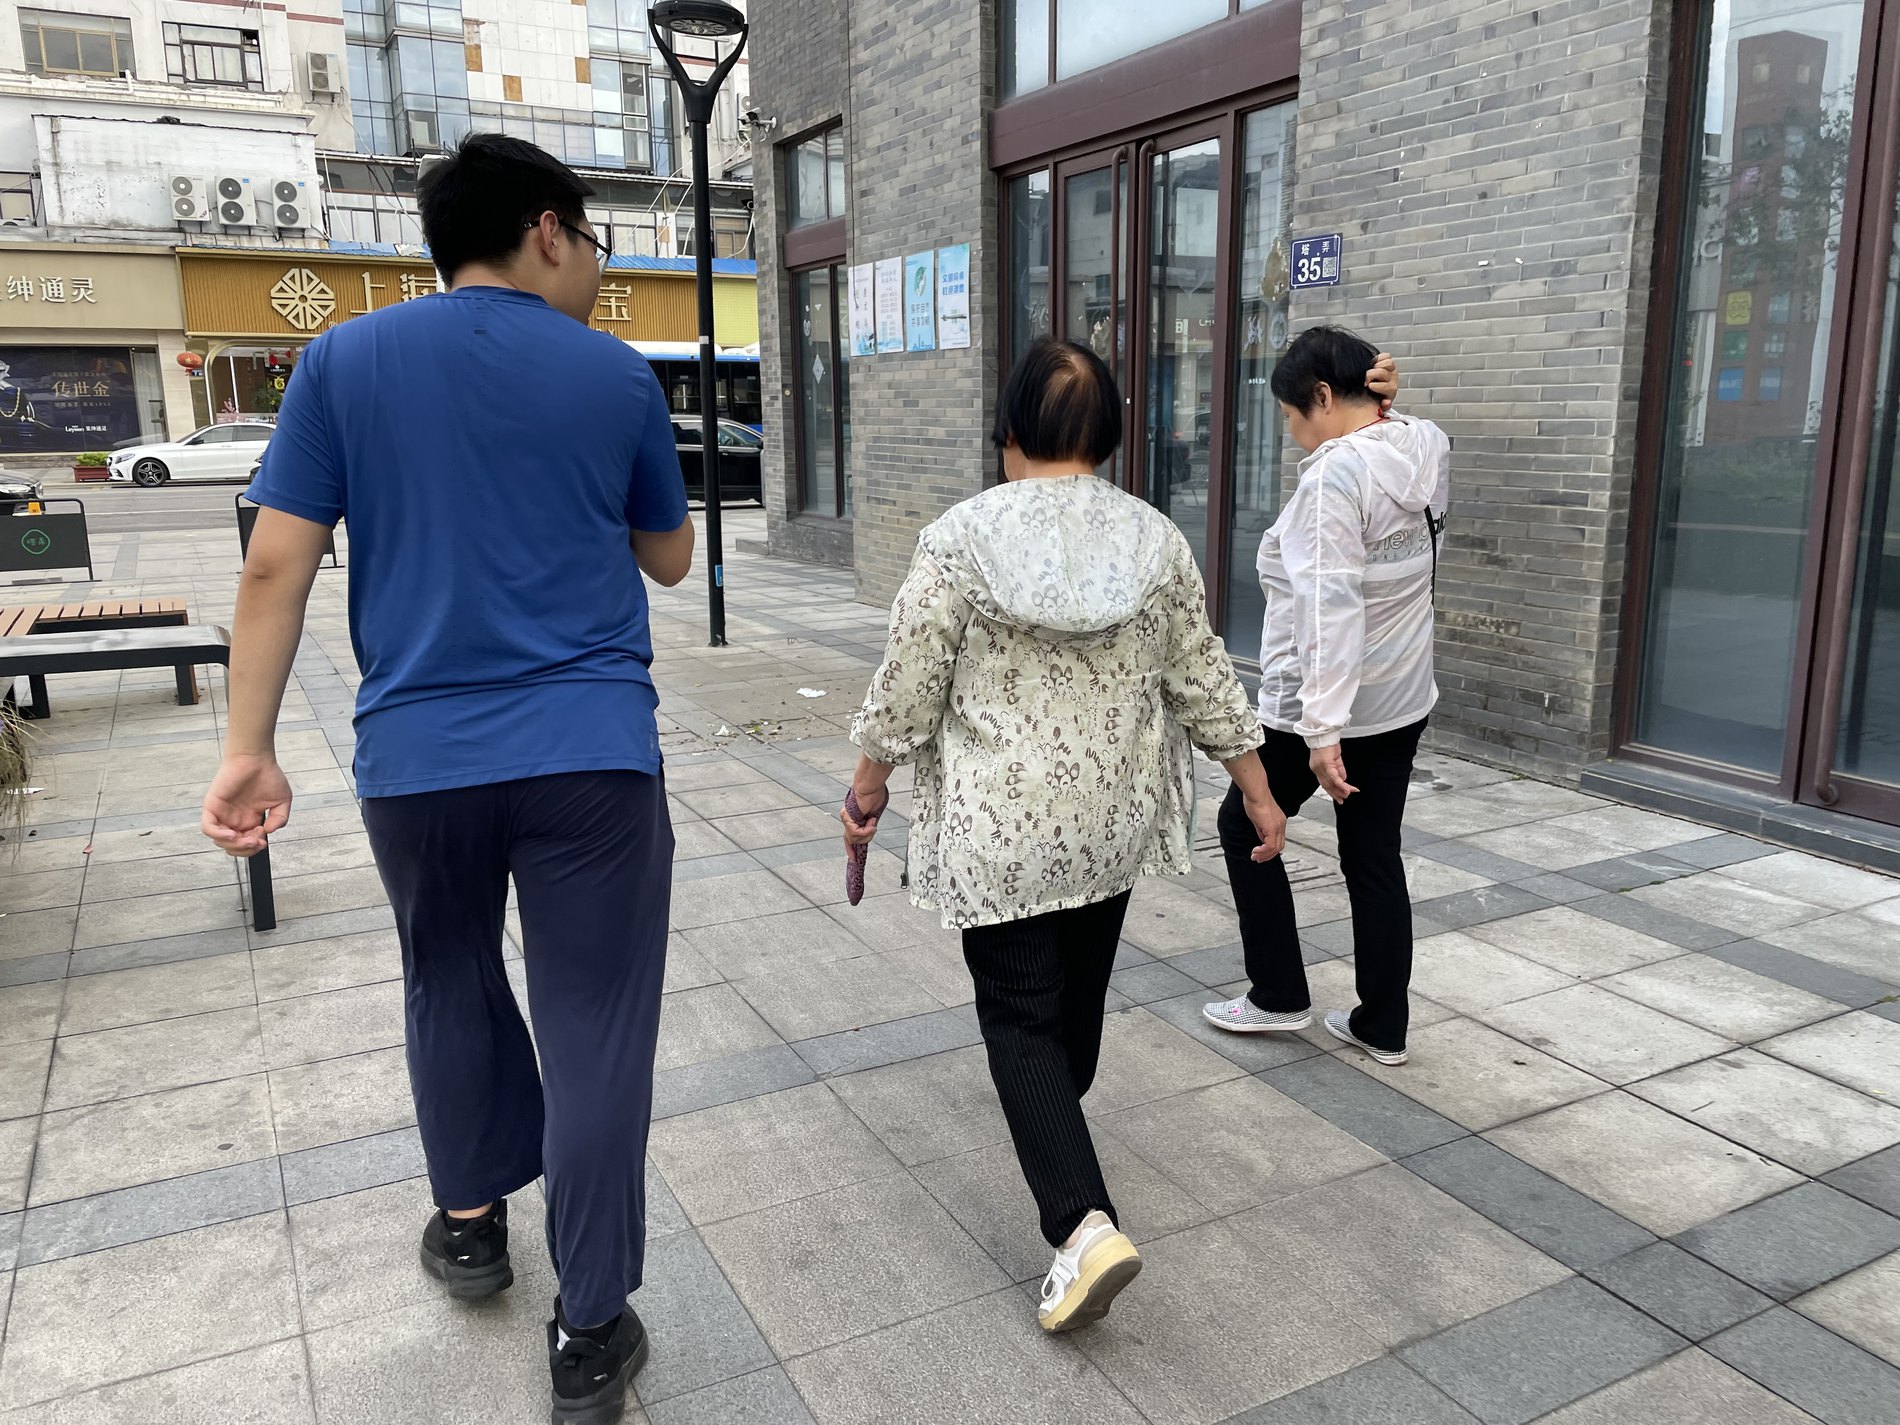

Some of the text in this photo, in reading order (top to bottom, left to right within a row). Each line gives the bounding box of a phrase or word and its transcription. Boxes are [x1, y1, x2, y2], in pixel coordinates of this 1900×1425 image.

[1297, 257, 1321, 283] 35
[0, 275, 97, 303] 绅通灵
[52, 380, 110, 398] 传世金
